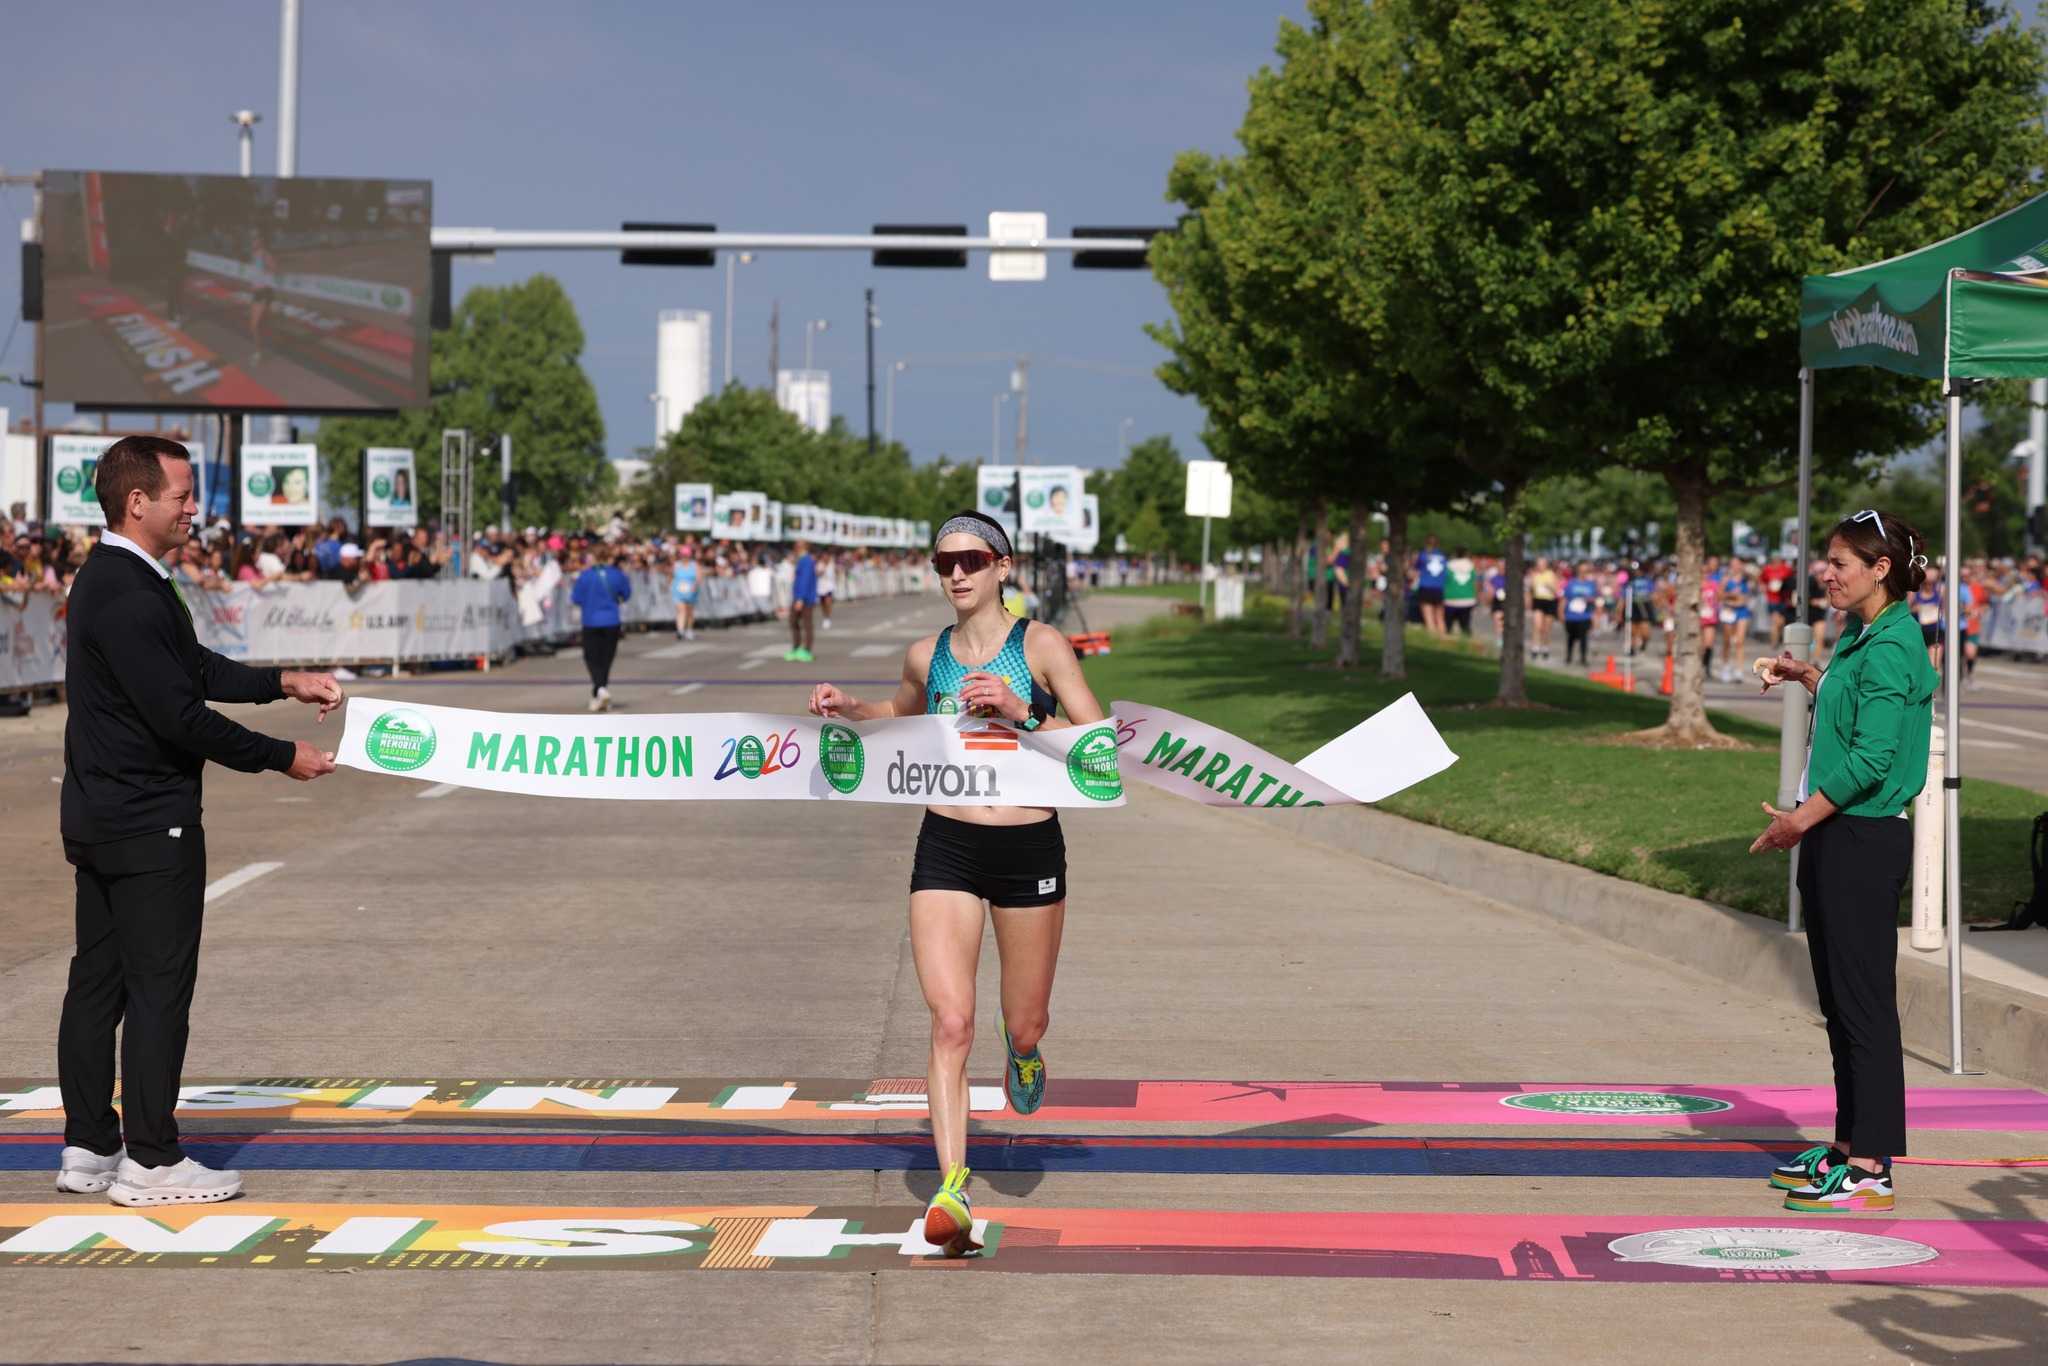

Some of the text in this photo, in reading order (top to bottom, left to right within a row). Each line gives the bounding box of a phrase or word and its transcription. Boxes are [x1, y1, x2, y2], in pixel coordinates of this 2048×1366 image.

[107, 312, 222, 394] FINISH
[380, 739, 421, 751] MEMORIAL
[467, 731, 694, 778] MARATHON
[887, 750, 1001, 797] devon
[1142, 731, 1326, 807] MARATH
